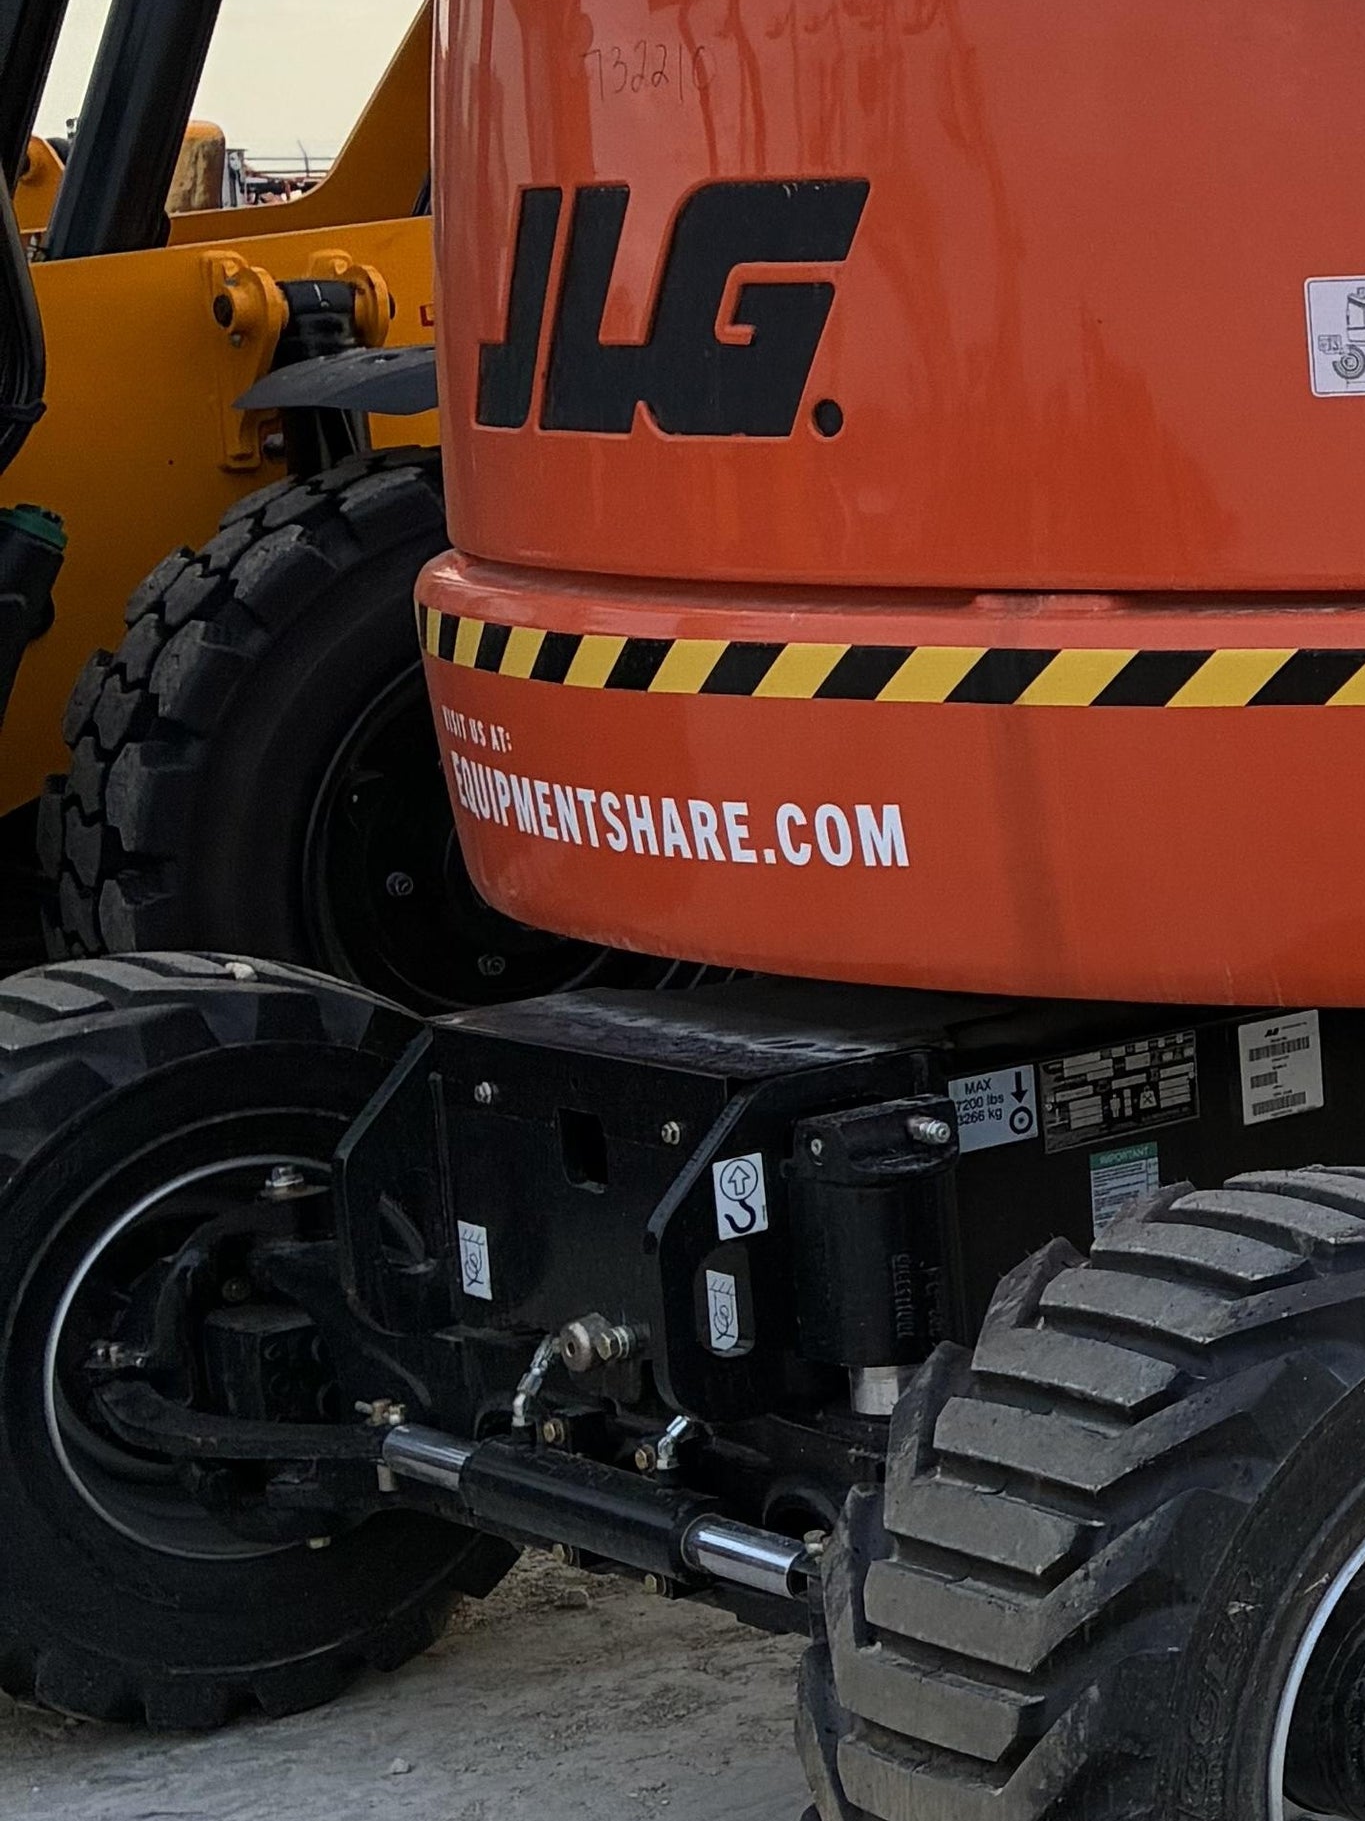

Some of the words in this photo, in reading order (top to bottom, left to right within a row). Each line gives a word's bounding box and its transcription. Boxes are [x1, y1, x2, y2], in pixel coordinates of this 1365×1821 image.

[469, 717, 487, 747] US
[451, 750, 910, 867] EQUIPMENTSHARE.COM
[964, 1076, 993, 1095] MAX
[988, 1106, 1003, 1122] kg
